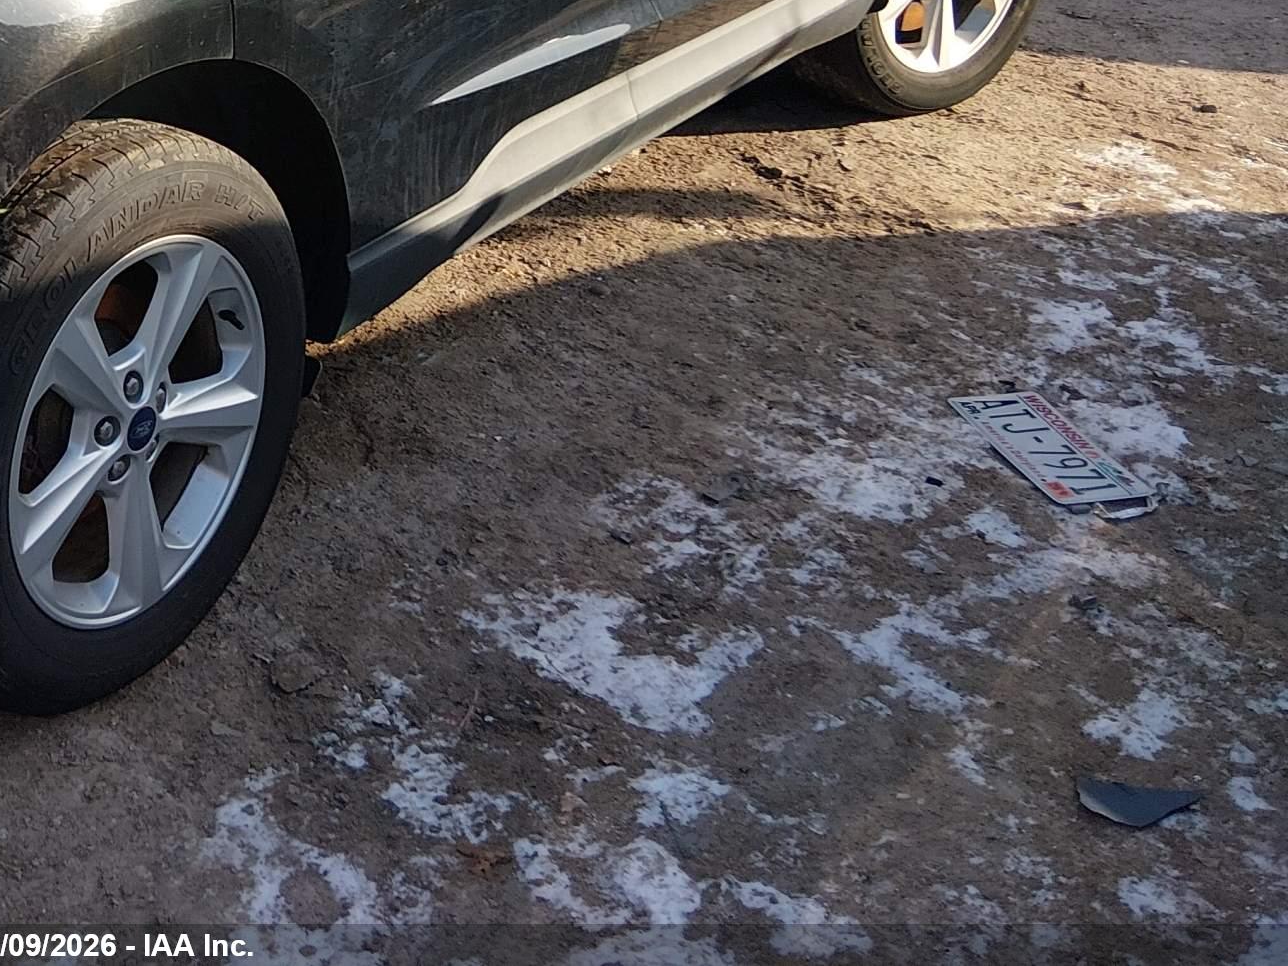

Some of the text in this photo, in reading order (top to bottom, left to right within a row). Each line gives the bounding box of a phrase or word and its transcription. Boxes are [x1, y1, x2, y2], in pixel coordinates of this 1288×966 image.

[214, 183, 265, 222] H/T
[972, 399, 1119, 495] ATJ-7971
[1023, 394, 1096, 452] WISCONSIN
